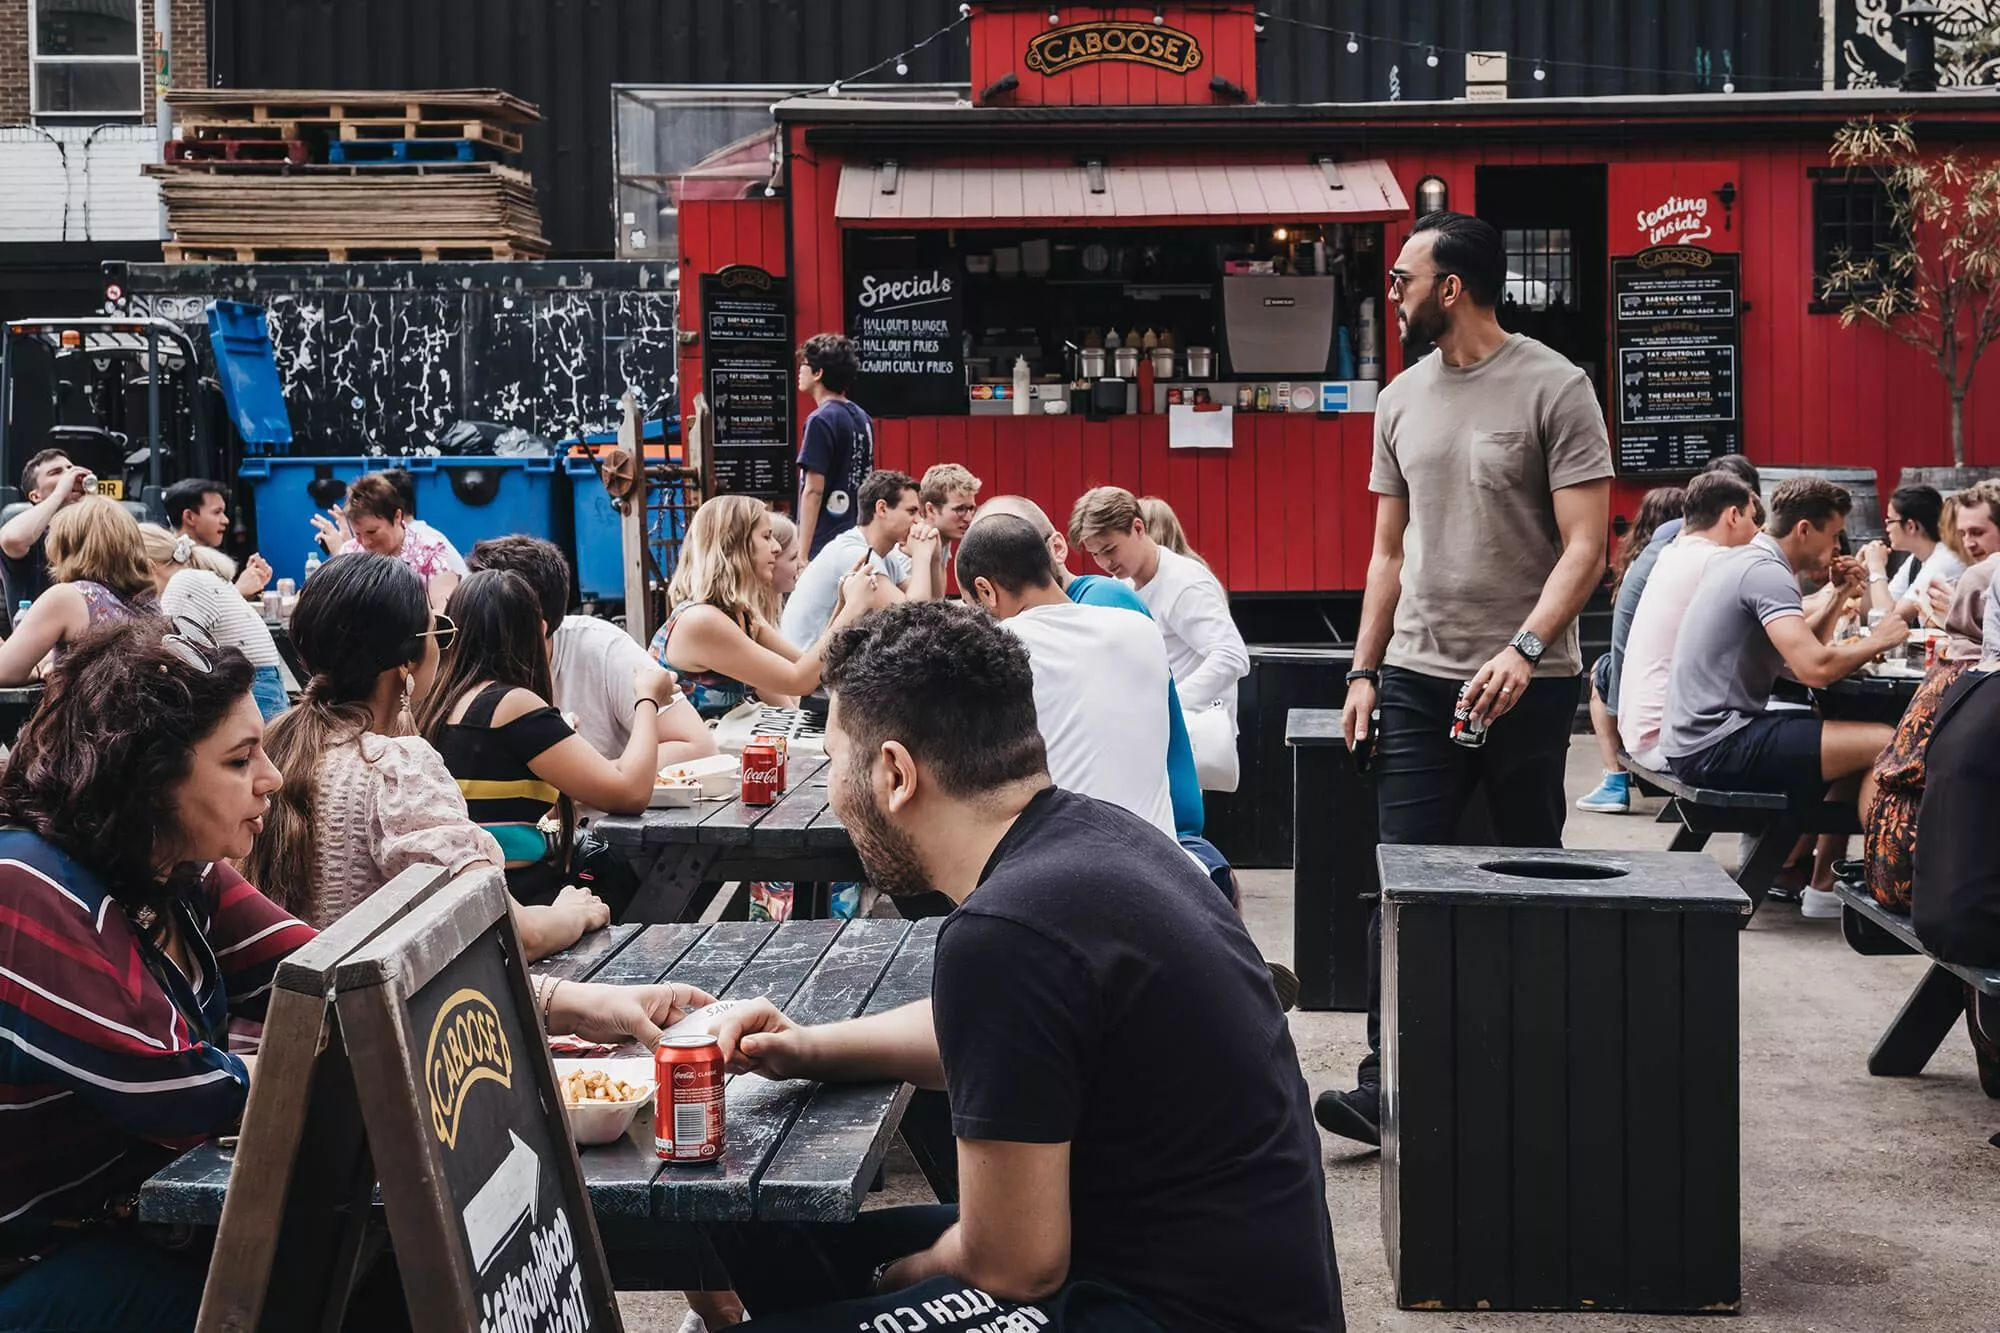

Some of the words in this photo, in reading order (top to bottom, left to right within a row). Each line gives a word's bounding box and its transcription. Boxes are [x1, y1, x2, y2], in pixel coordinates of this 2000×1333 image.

[1043, 29, 1184, 63] CABOOSE
[1637, 196, 1708, 232] Seating
[1650, 213, 1701, 245] inside
[858, 270, 952, 308] Specials
[863, 318, 909, 331] HALLOUMI
[911, 319, 949, 332] BURGER
[863, 339, 911, 353] HALLOUMI
[913, 340, 940, 353] FRIES
[893, 360, 925, 373] CURLY
[926, 360, 954, 374] FRIES
[434, 1009, 504, 1117] CABOOSE
